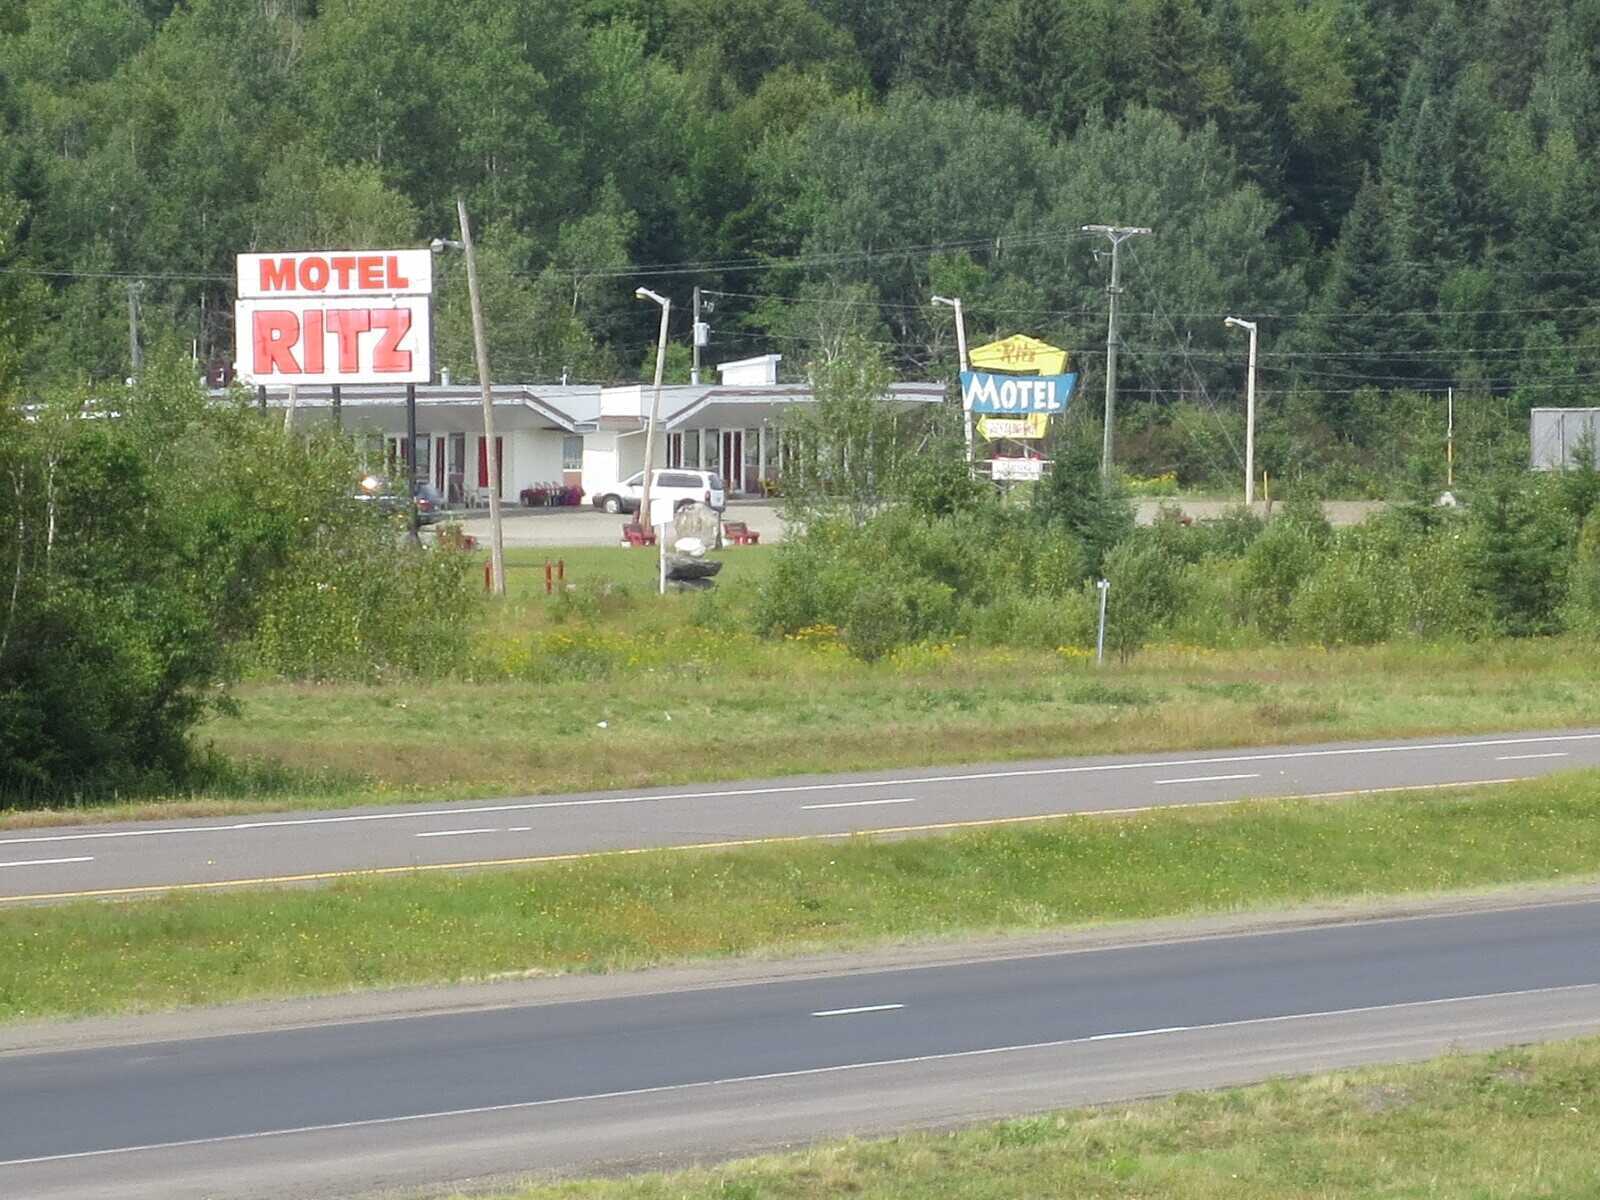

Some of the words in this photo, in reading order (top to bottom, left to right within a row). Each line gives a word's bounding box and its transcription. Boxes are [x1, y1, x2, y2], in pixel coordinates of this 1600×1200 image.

[259, 256, 409, 291] MOTEL
[252, 308, 412, 374] RITZ
[962, 374, 1061, 410] MOTEL
